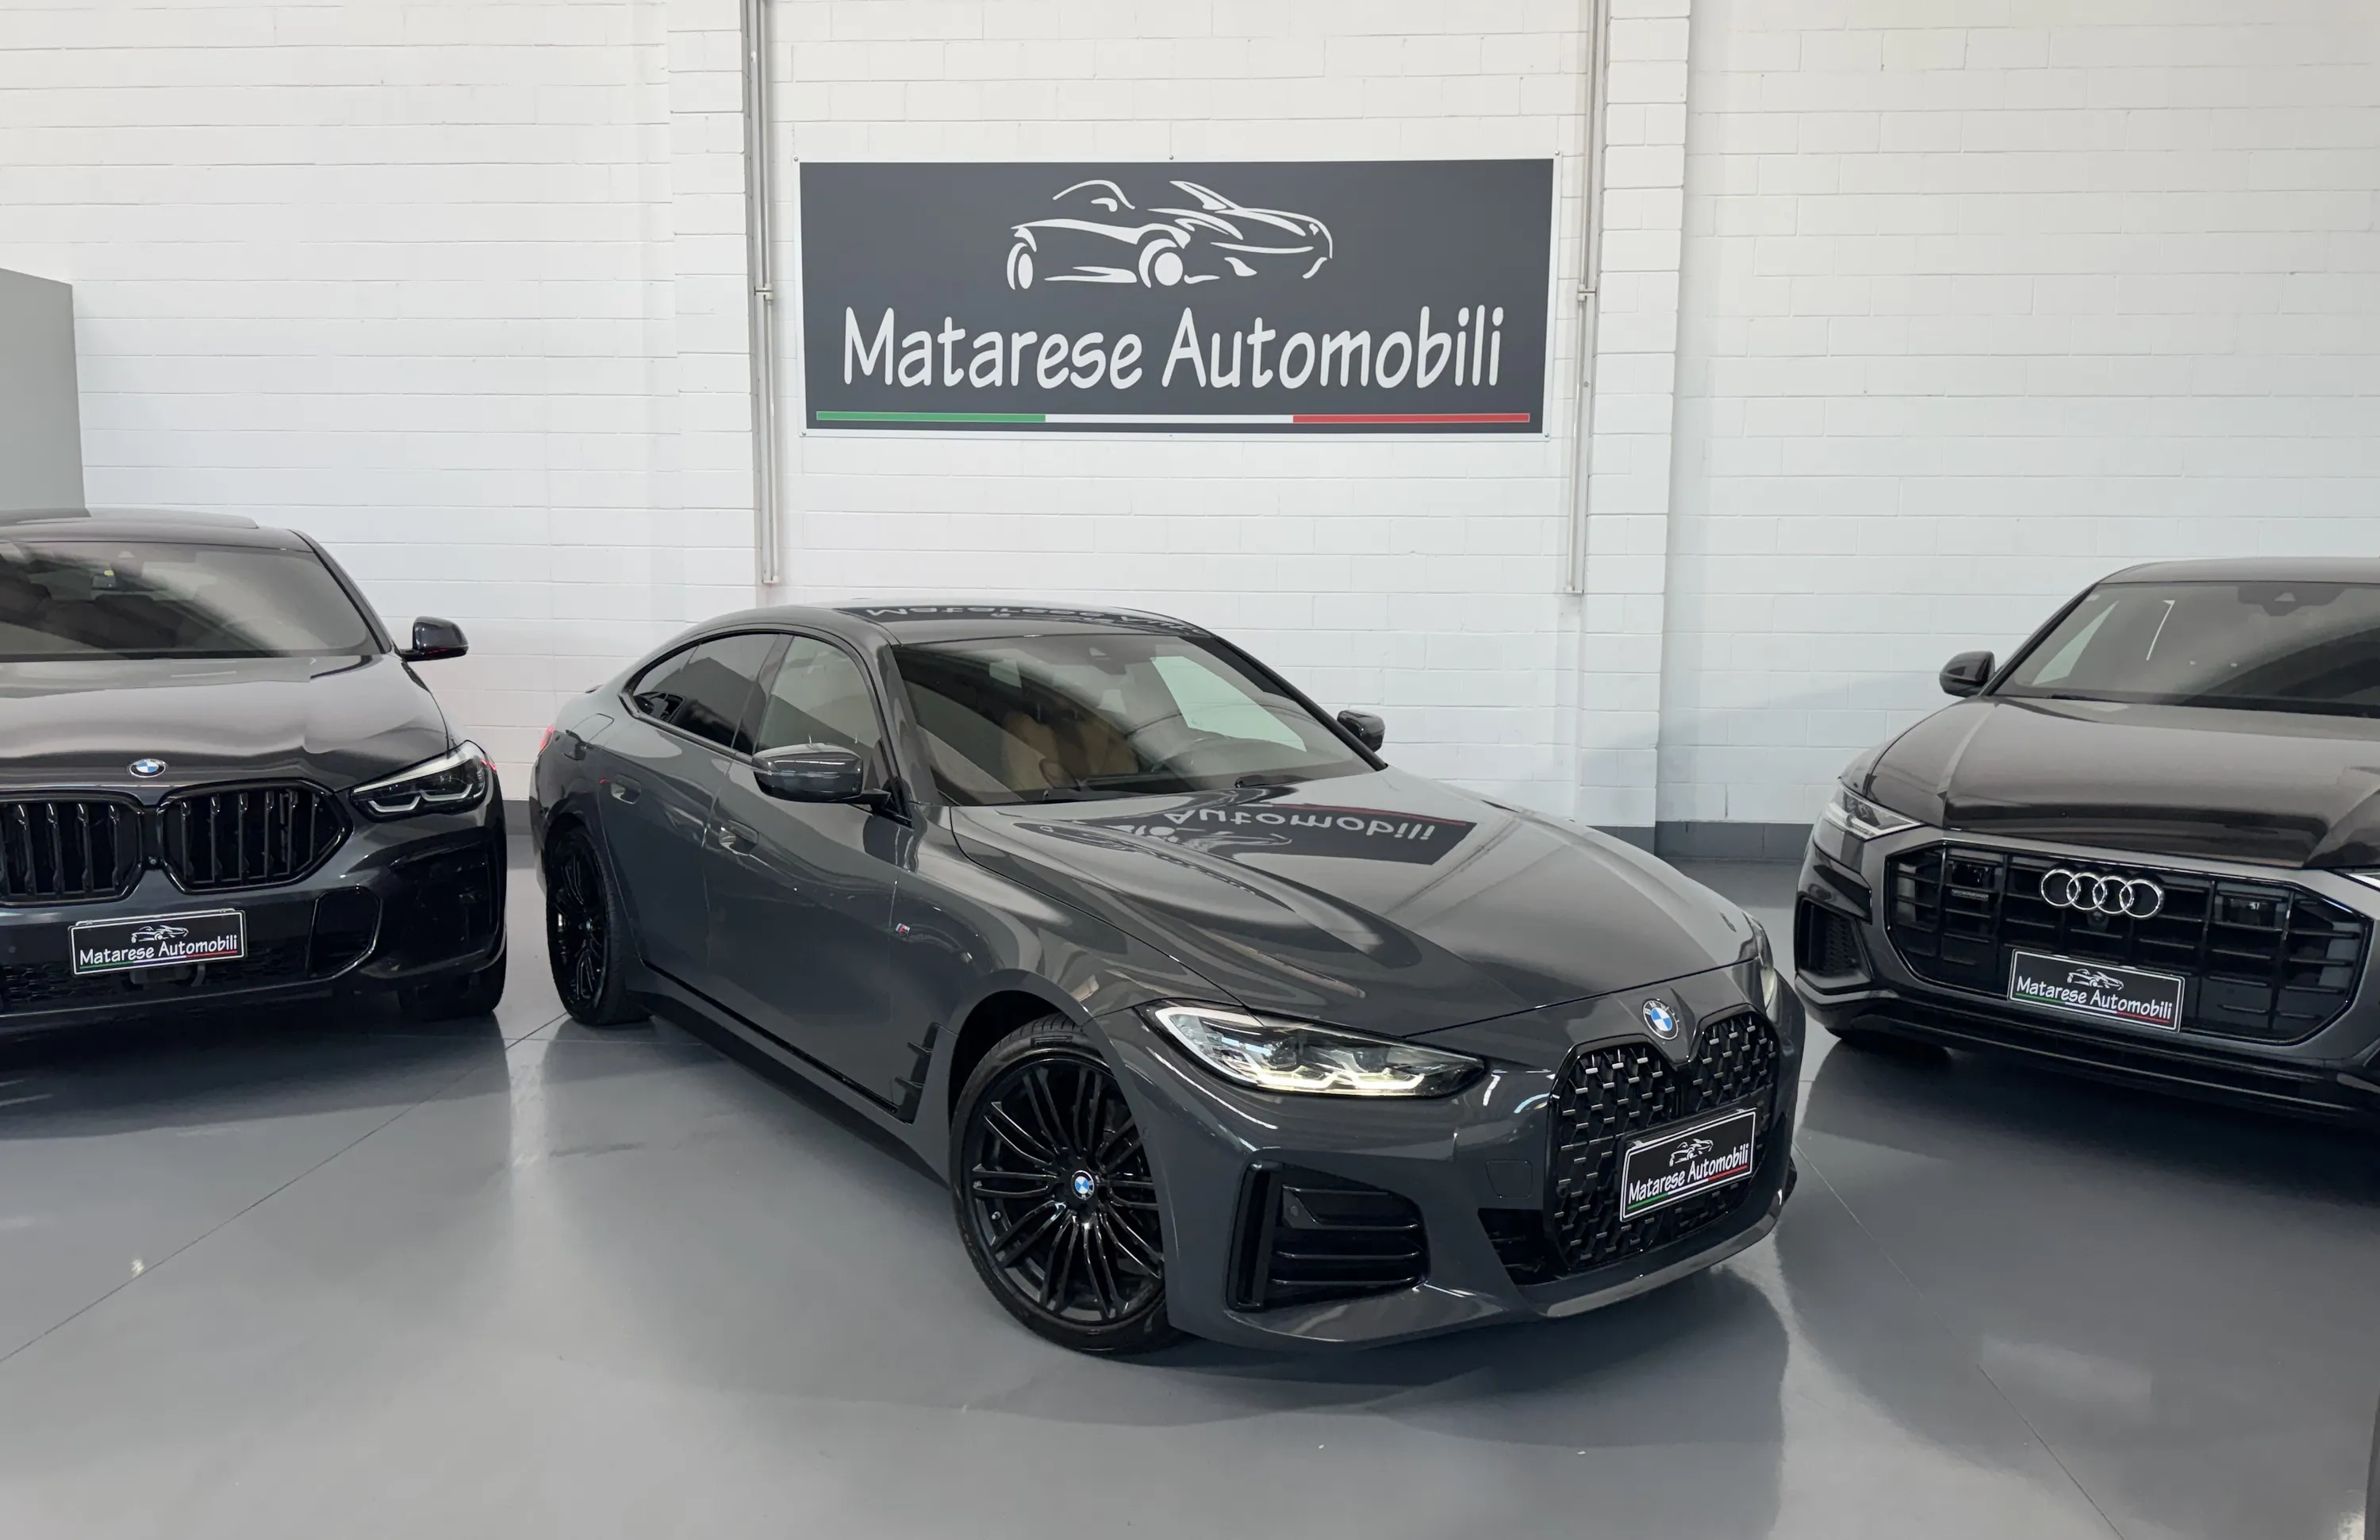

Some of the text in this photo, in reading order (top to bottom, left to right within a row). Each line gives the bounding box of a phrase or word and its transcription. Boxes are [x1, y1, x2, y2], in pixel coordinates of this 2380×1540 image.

[843, 305, 1505, 390] Matarese Automobili
[79, 935, 237, 966] Matarese Automobili
[2016, 975, 2173, 1020] Matarese Automobili
[1628, 1143, 1749, 1204] Matarese Automobili
